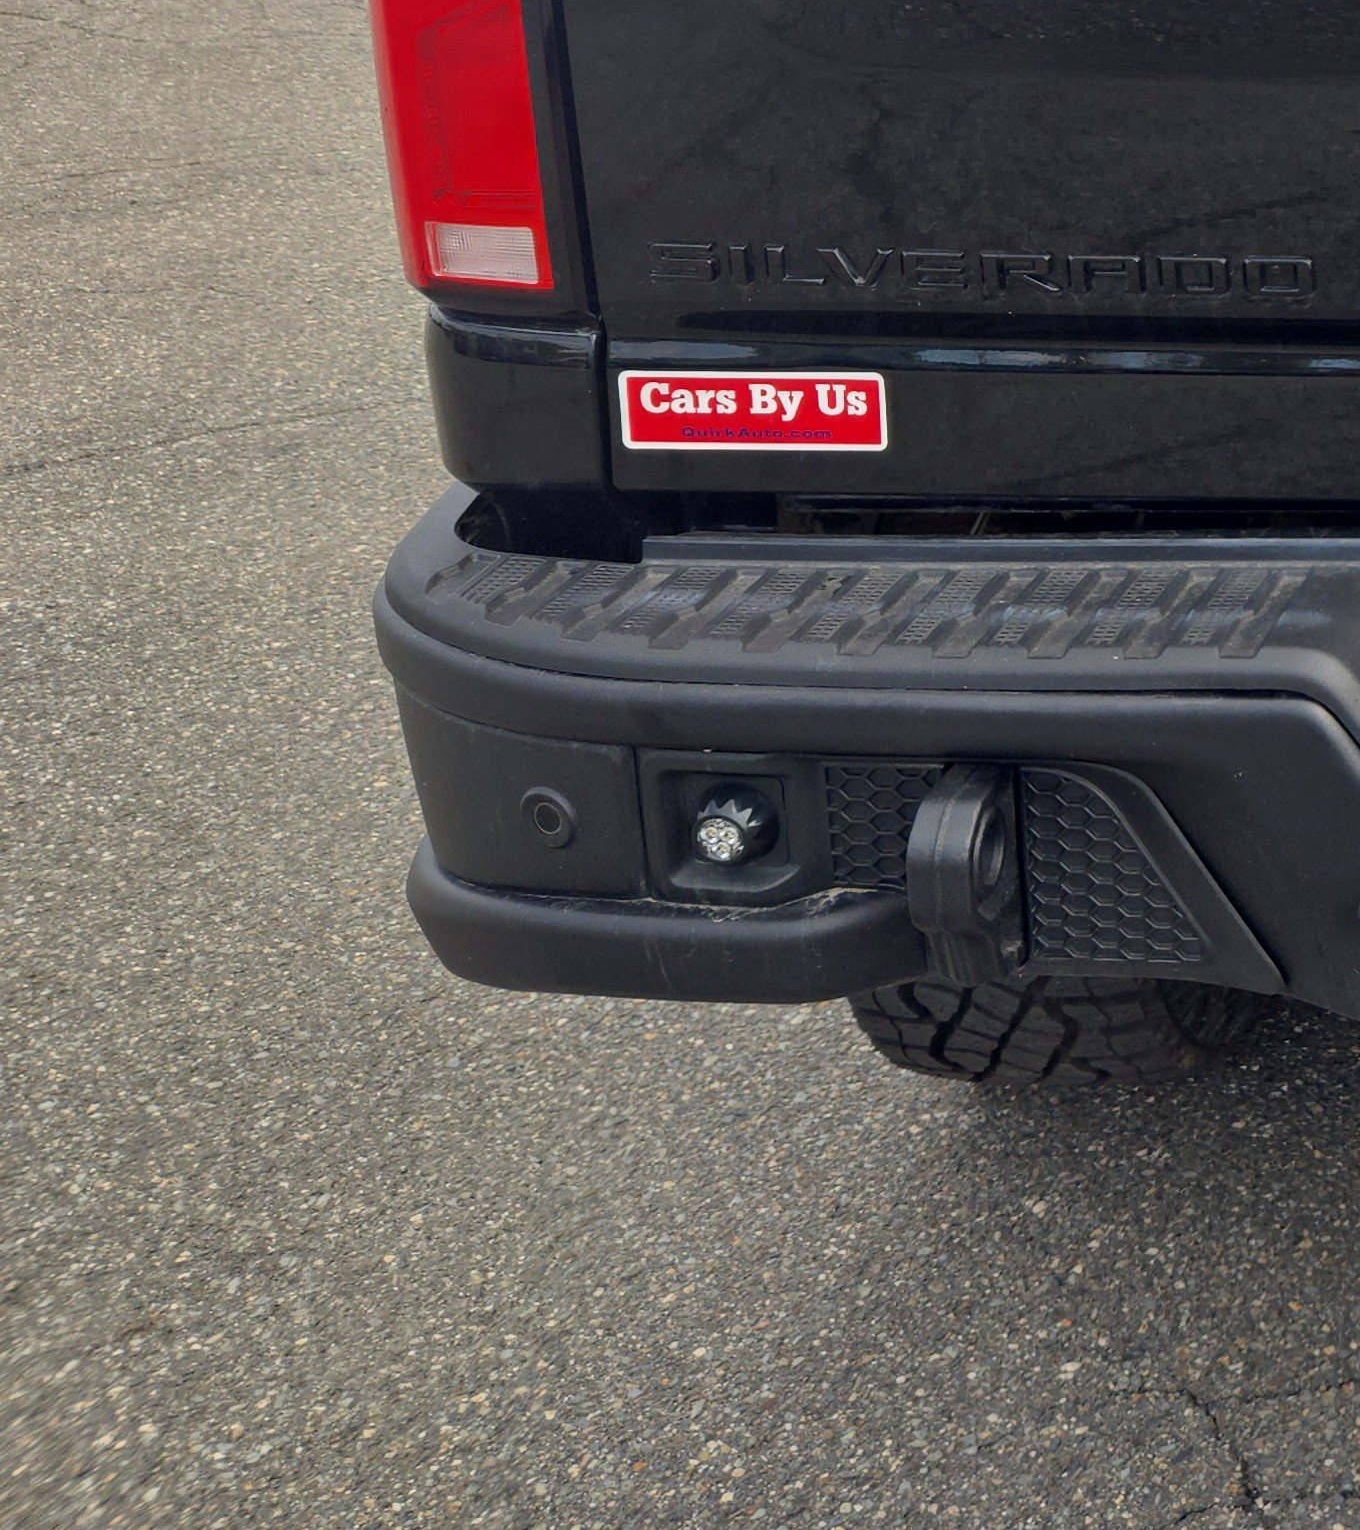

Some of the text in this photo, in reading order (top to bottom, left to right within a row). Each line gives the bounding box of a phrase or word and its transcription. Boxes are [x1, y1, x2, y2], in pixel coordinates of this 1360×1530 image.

[648, 241, 1318, 298] SILVERADO
[640, 381, 868, 421] Cars By Us
